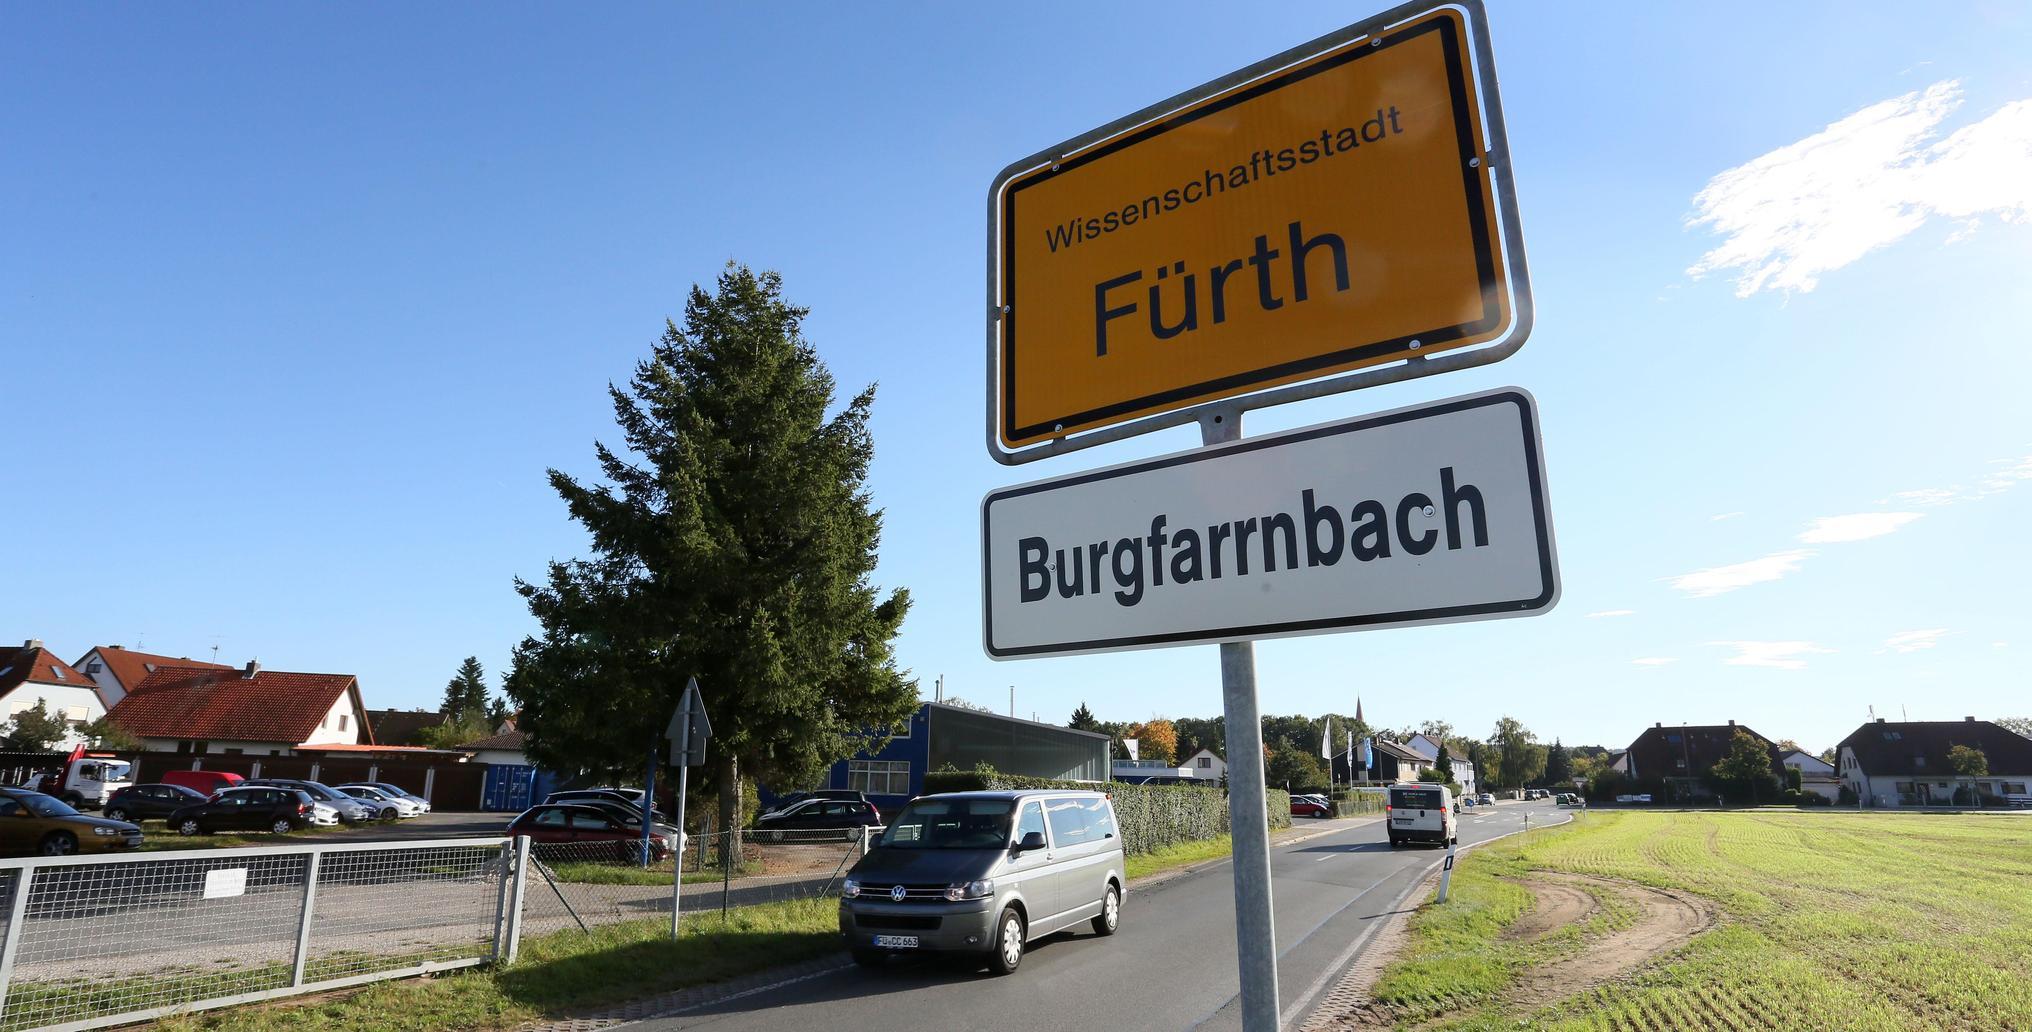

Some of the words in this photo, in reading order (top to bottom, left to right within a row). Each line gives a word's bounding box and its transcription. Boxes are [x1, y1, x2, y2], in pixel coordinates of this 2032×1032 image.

[1046, 106, 1404, 253] Wissenschaftsstadt
[1095, 221, 1350, 357] Fürth
[1018, 466, 1489, 607] Burgfarrnbach
